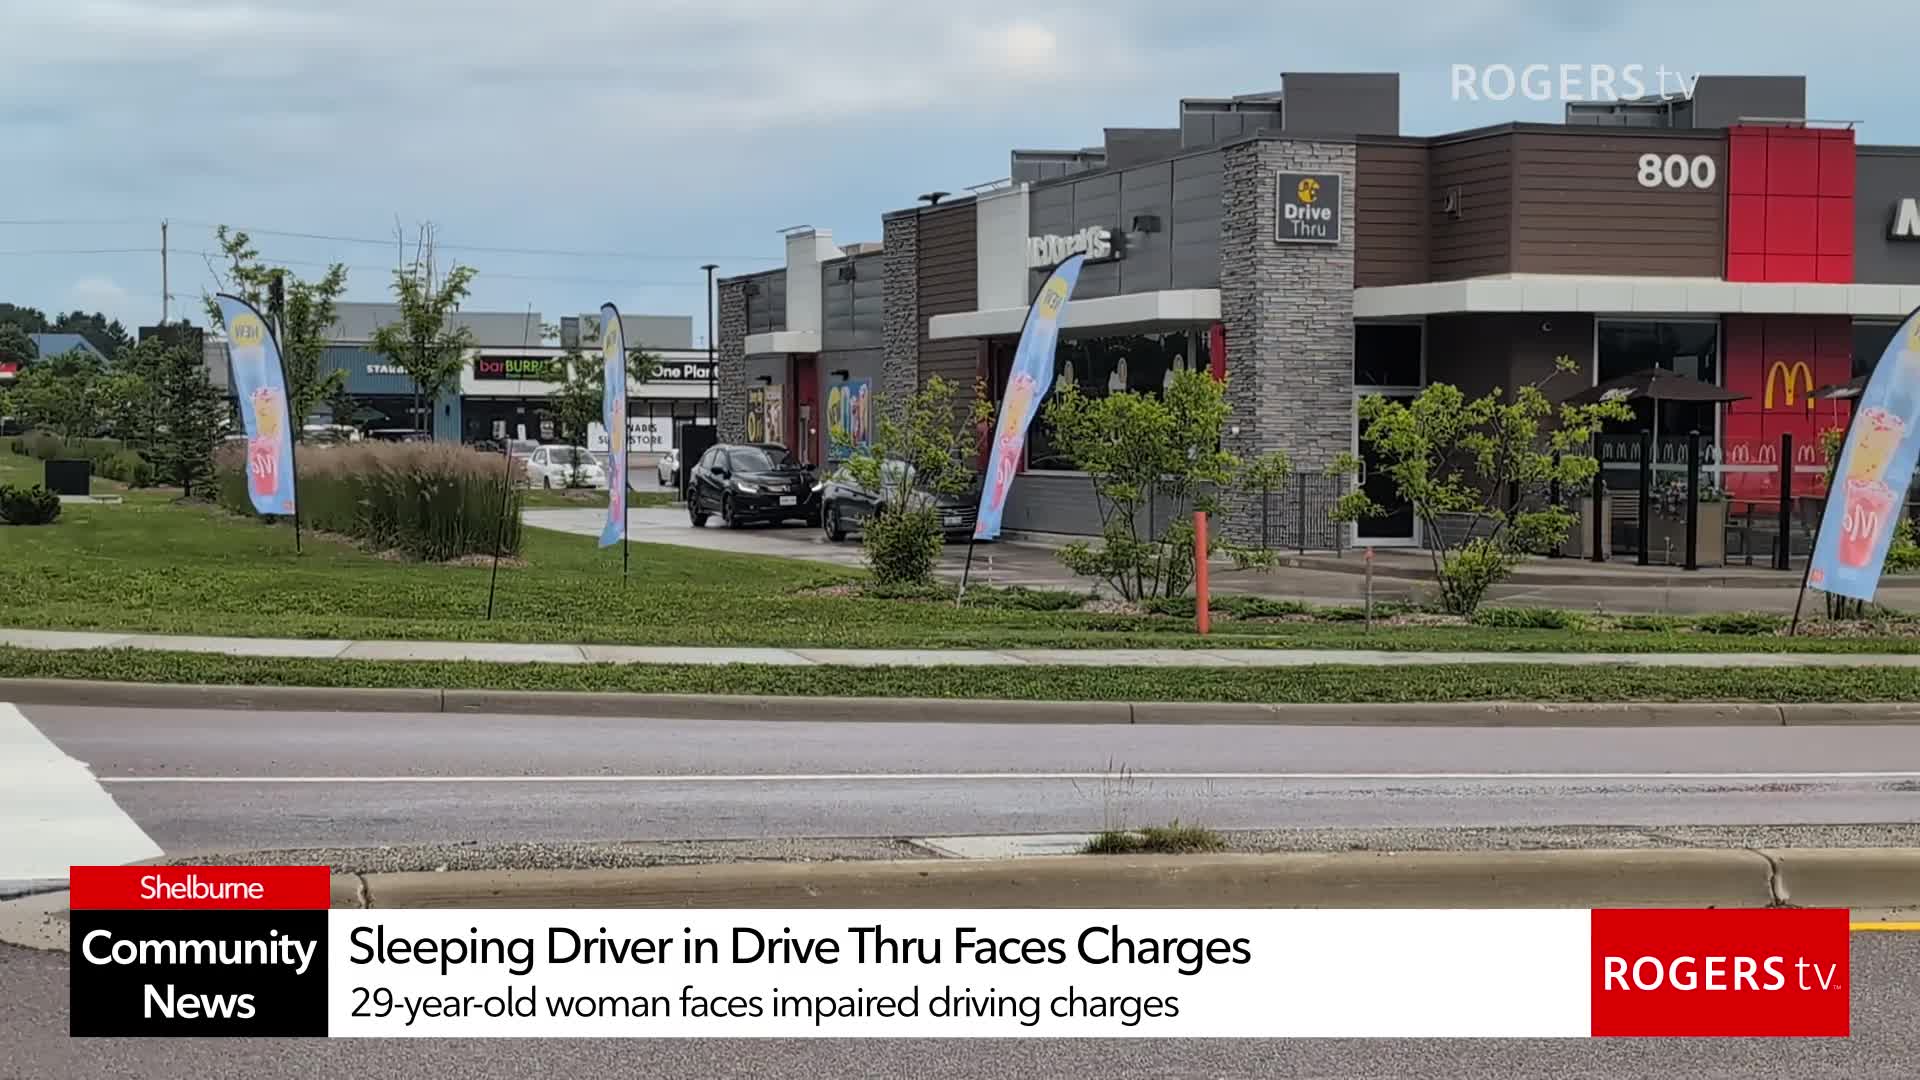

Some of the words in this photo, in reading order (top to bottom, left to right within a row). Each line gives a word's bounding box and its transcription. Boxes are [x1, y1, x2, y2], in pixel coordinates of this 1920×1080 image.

[1637, 153, 1716, 188] 800
[1284, 203, 1332, 220] Drive
[1291, 219, 1326, 237] Thru
[651, 364, 681, 378] One
